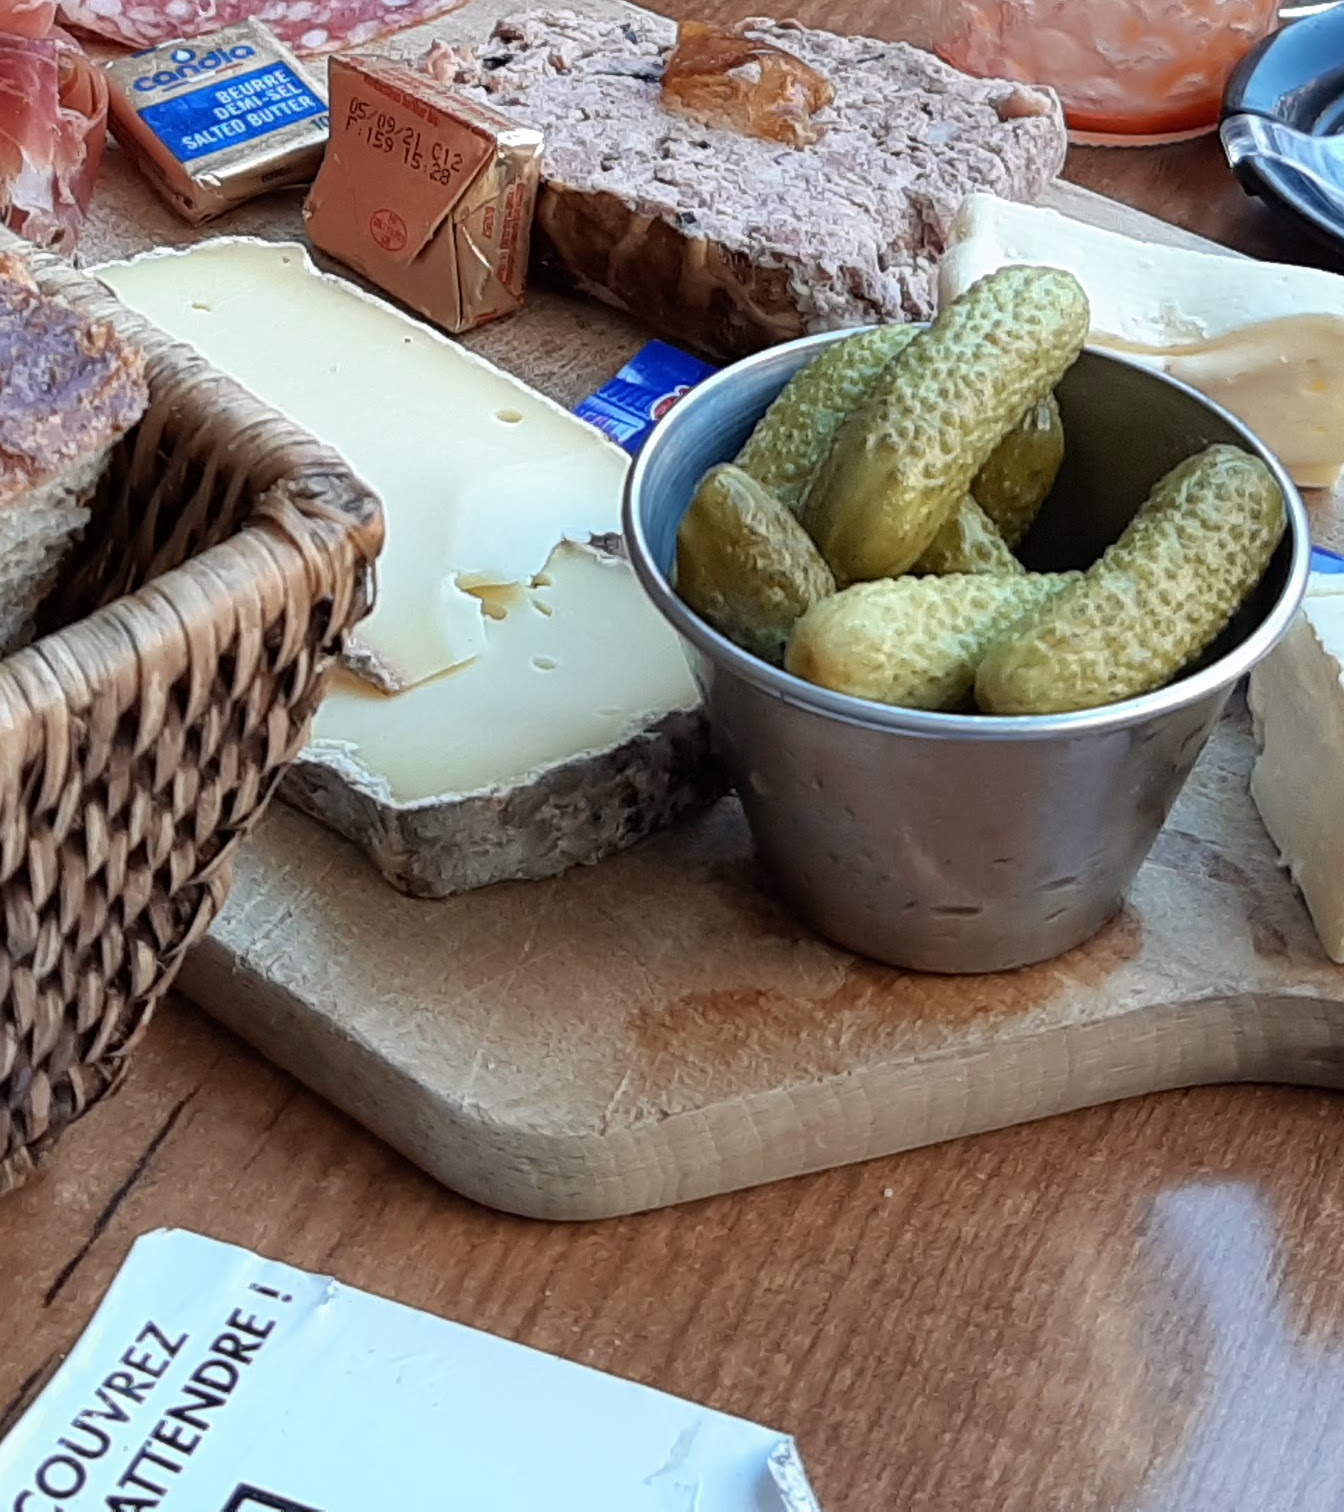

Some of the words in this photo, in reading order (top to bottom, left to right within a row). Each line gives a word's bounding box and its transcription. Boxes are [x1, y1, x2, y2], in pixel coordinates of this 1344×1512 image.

[133, 45, 256, 92] candia
[215, 69, 292, 105] BEURRE
[182, 119, 247, 151] SALTED
[247, 95, 317, 128] BUTTER
[213, 85, 303, 121] DEMI-SEL
[349, 97, 421, 152] 05/09/21
[431, 142, 463, 173] C12
[404, 146, 452, 187] 15:28
